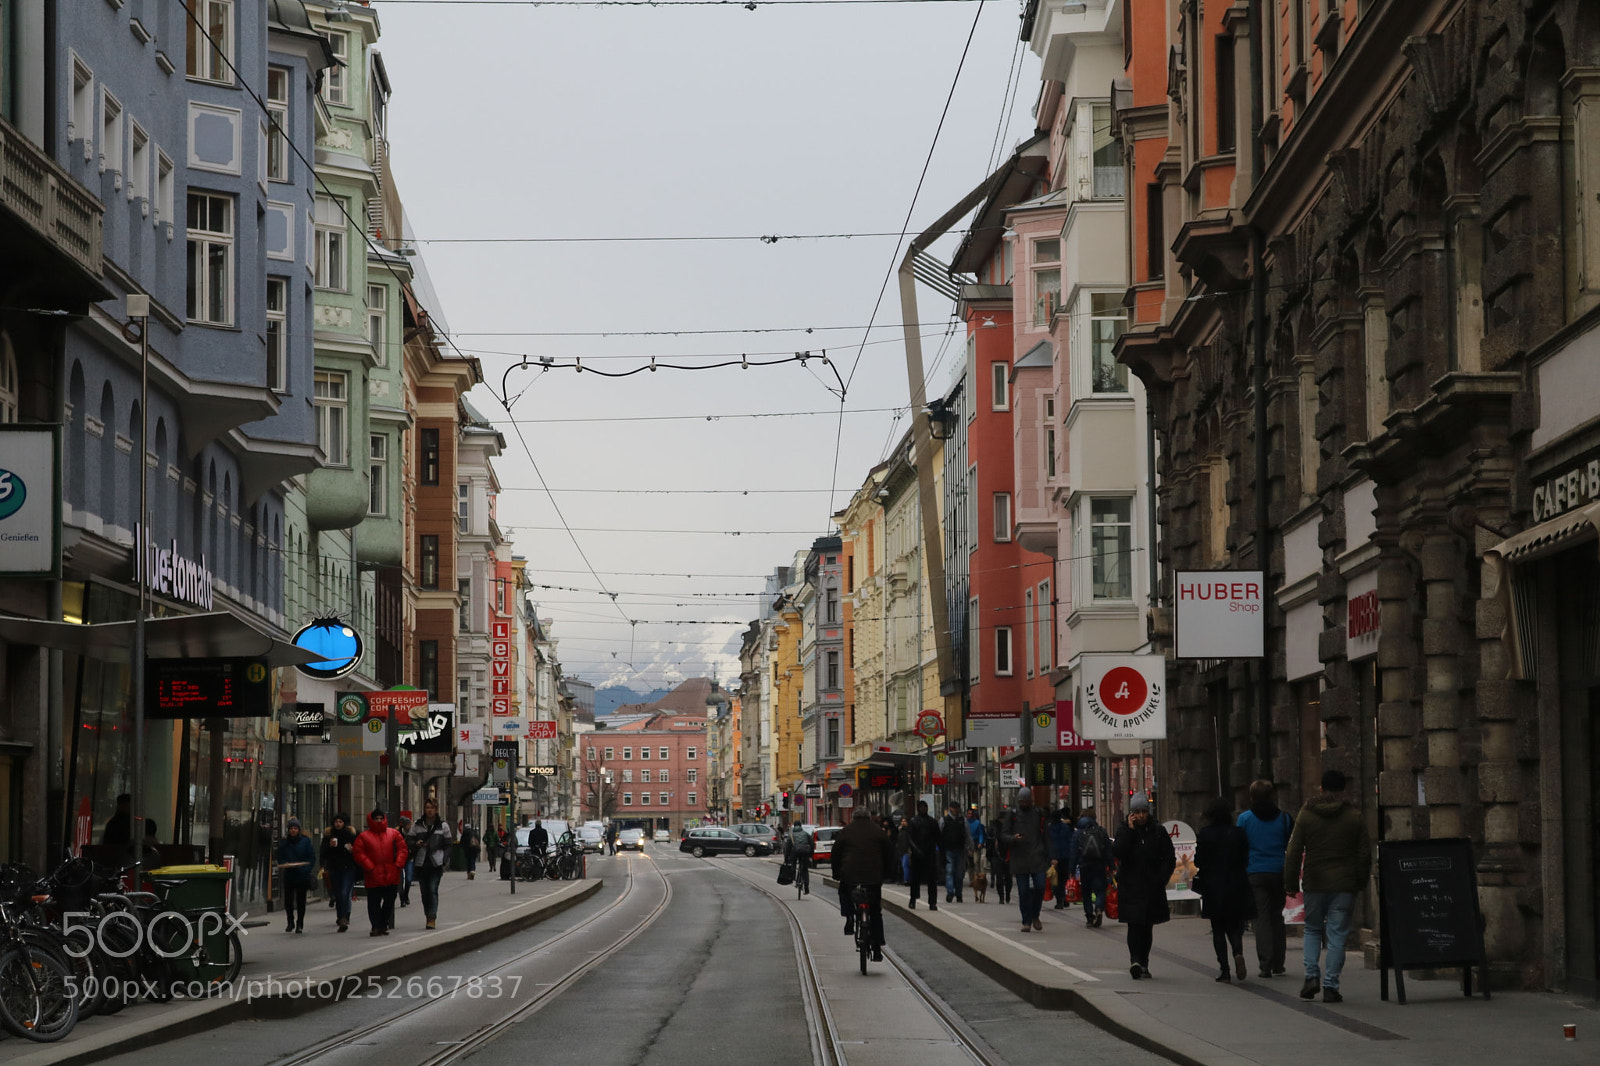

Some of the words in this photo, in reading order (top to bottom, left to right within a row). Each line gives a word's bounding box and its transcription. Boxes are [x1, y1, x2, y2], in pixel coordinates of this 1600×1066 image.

[1, 533, 39, 541] Genießen
[1180, 583, 1260, 600] HUBER
[1229, 602, 1260, 614] Shop
[295, 711, 324, 722] Kiehl's
[1087, 698, 1118, 729] ZENTRAL
[1123, 697, 1160, 729] APOTHEKE
